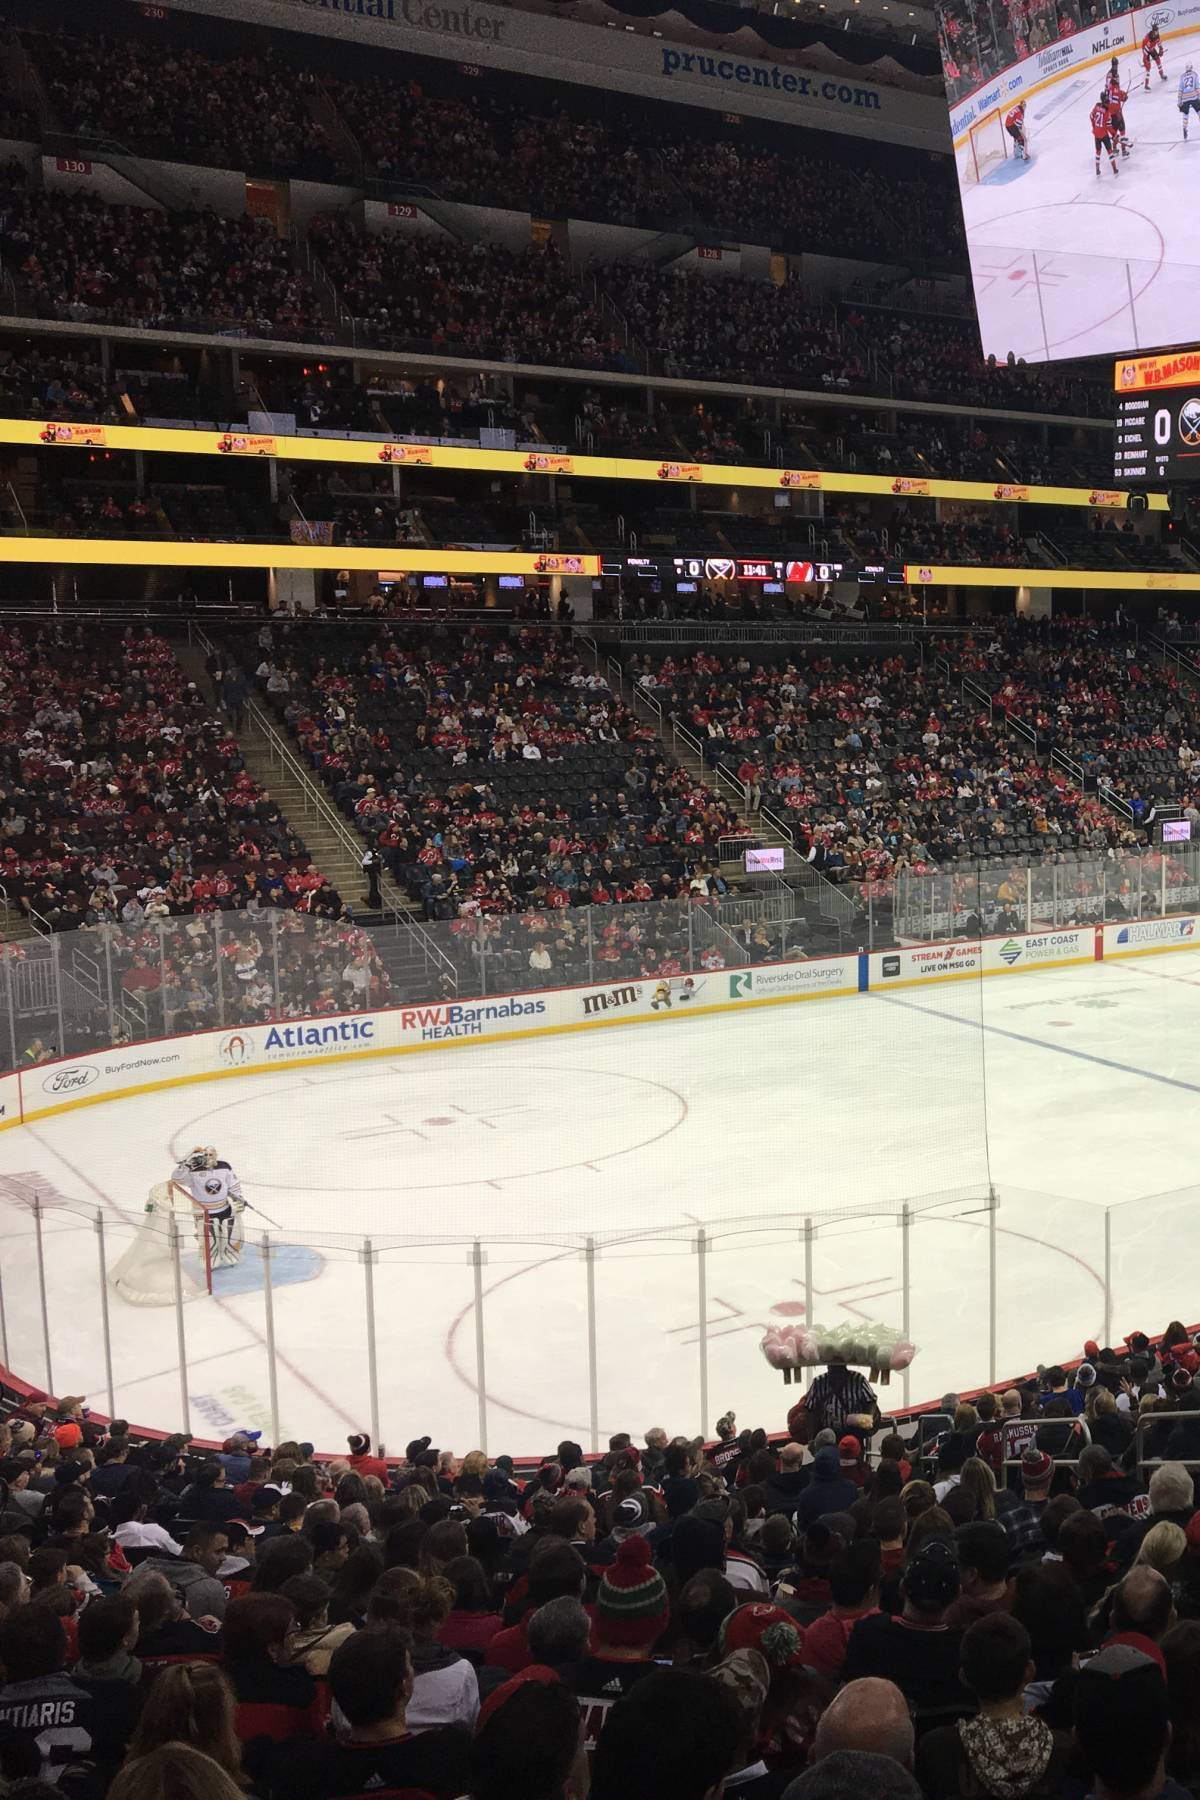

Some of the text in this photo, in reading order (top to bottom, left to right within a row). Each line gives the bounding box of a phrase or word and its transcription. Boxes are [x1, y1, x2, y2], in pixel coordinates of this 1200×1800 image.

[144, 8, 164, 18] 230
[399, 0, 505, 40] Center
[1151, 11, 1170, 26] Ford
[1092, 36, 1125, 54] NHL.COM
[661, 48, 881, 109] prucenter.com
[1183, 75, 1194, 89] 23
[978, 88, 1000, 111] Walmart
[1008, 75, 1023, 90] com
[1095, 113, 1104, 127] 21
[64, 160, 85, 173] 130
[394, 205, 412, 217] 129
[702, 248, 718, 260] 128
[1144, 355, 1200, 384] W.B.MASON
[1116, 419, 1122, 427] 19
[1155, 409, 1171, 444] 0
[1124, 434, 1142, 443] EICHEL
[1124, 467, 1146, 476] SKINNER
[1159, 466, 1164, 476] 6
[689, 561, 699, 576] 0
[743, 564, 766, 575] 11:41
[820, 566, 829, 579] 0
[1128, 922, 1183, 943] HALMAR
[1026, 934, 1079, 948] EAST COAST
[911, 946, 983, 963] STREAM GAMES
[1026, 945, 1080, 960] POWER GAS
[921, 959, 975, 973] LIVE ON MSG GO
[756, 967, 845, 985] Riverside Oral Surgery
[401, 998, 546, 1031] RWJBarnabas
[265, 1017, 374, 1051] Atlantic
[422, 1022, 482, 1041] HEALTH
[52, 1053, 181, 1092] Ford BuyFordNow.com
